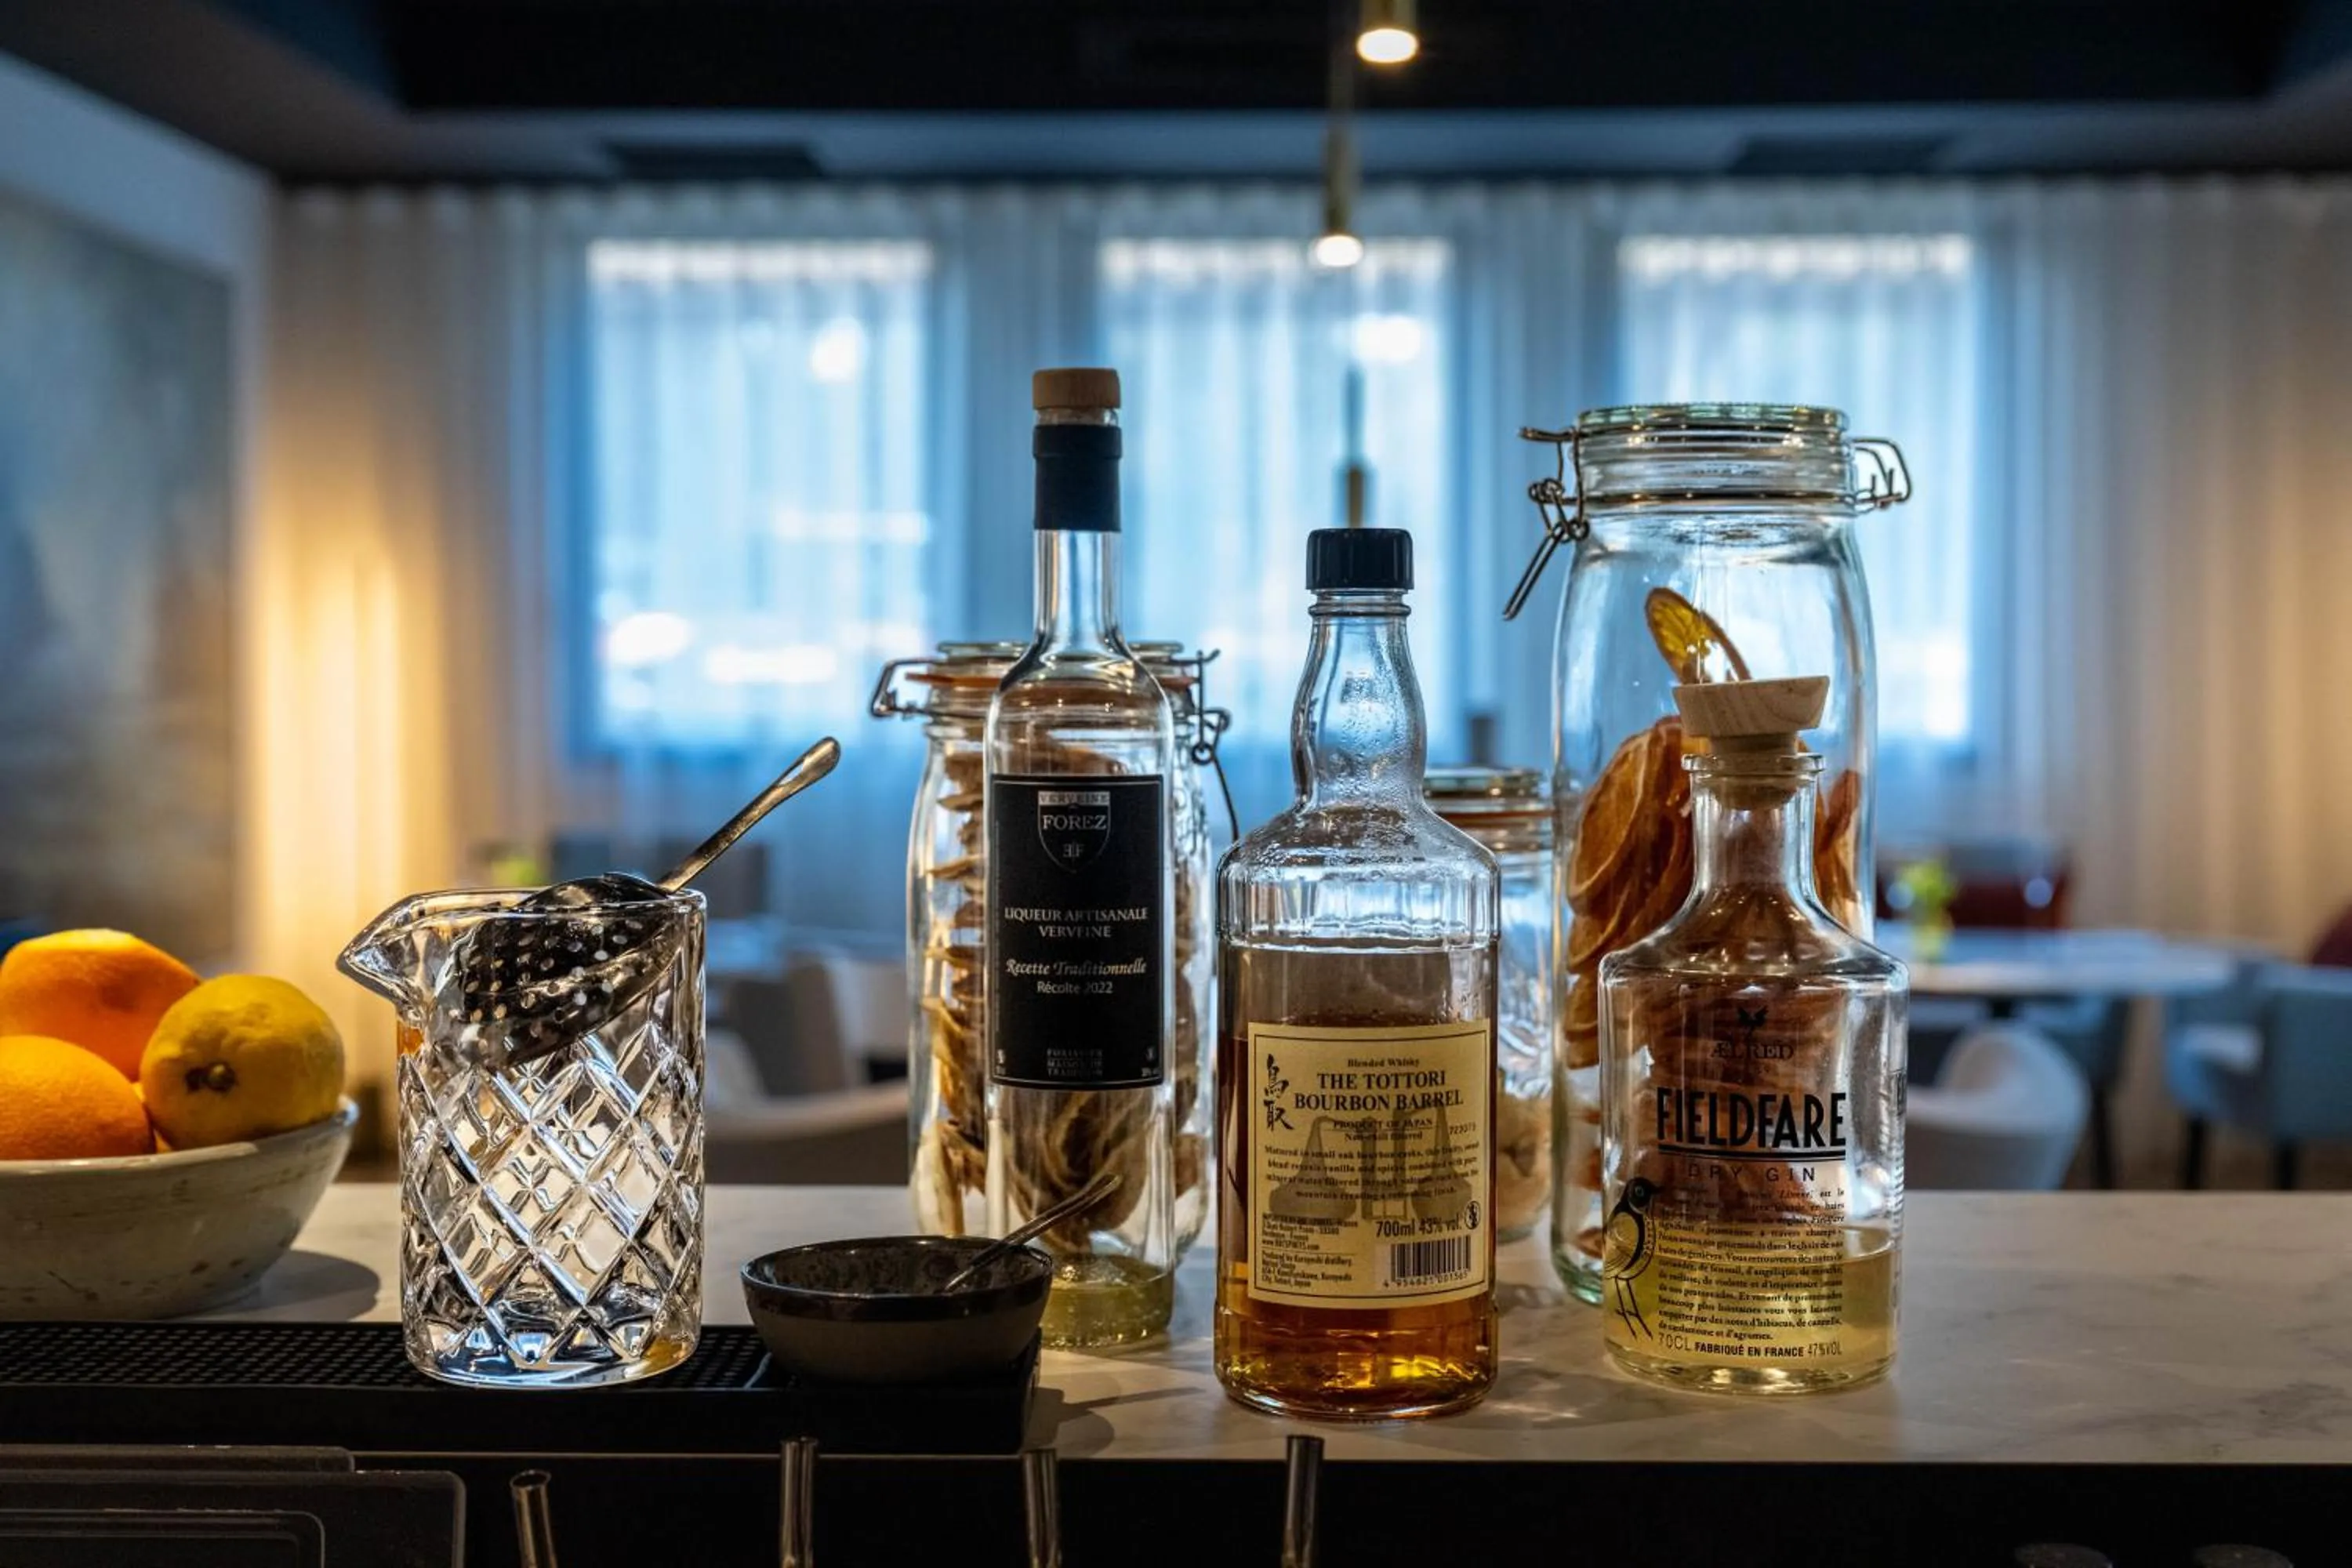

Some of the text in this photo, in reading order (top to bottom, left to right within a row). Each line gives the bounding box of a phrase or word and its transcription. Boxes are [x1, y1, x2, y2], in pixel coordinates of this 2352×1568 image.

[1040, 793, 1109, 804] VERVEINE
[1042, 814, 1108, 831] FOREZ
[1004, 906, 1149, 923] LIQUEUR ARTISANALE
[1039, 925, 1112, 938] VERVEINE
[1006, 956, 1147, 977] Recette Traditionnelle
[1036, 980, 1113, 994] Récolte 2022
[1347, 1058, 1420, 1068] Blended Whisky
[1316, 1070, 1446, 1091] THE TOTTORI
[1264, 1053, 1294, 1131] 鳥取
[1294, 1089, 1464, 1112] BOURBON BARREL
[1402, 1118, 1433, 1127] JAPAN
[1657, 1086, 1847, 1149] FIELDFARE
[1311, 1150, 1335, 1159] small
[1689, 1163, 1816, 1181] DRY GIN
[1374, 1218, 1416, 1238] 700ml
[1418, 1217, 1443, 1236] 43%
[1446, 1212, 1463, 1232] vol.
[1658, 1332, 1691, 1351] 70CL
[1694, 1341, 1744, 1356] FABRIQUÉ
[1748, 1346, 1761, 1357] EN
[1764, 1345, 1804, 1358] FRANCE
